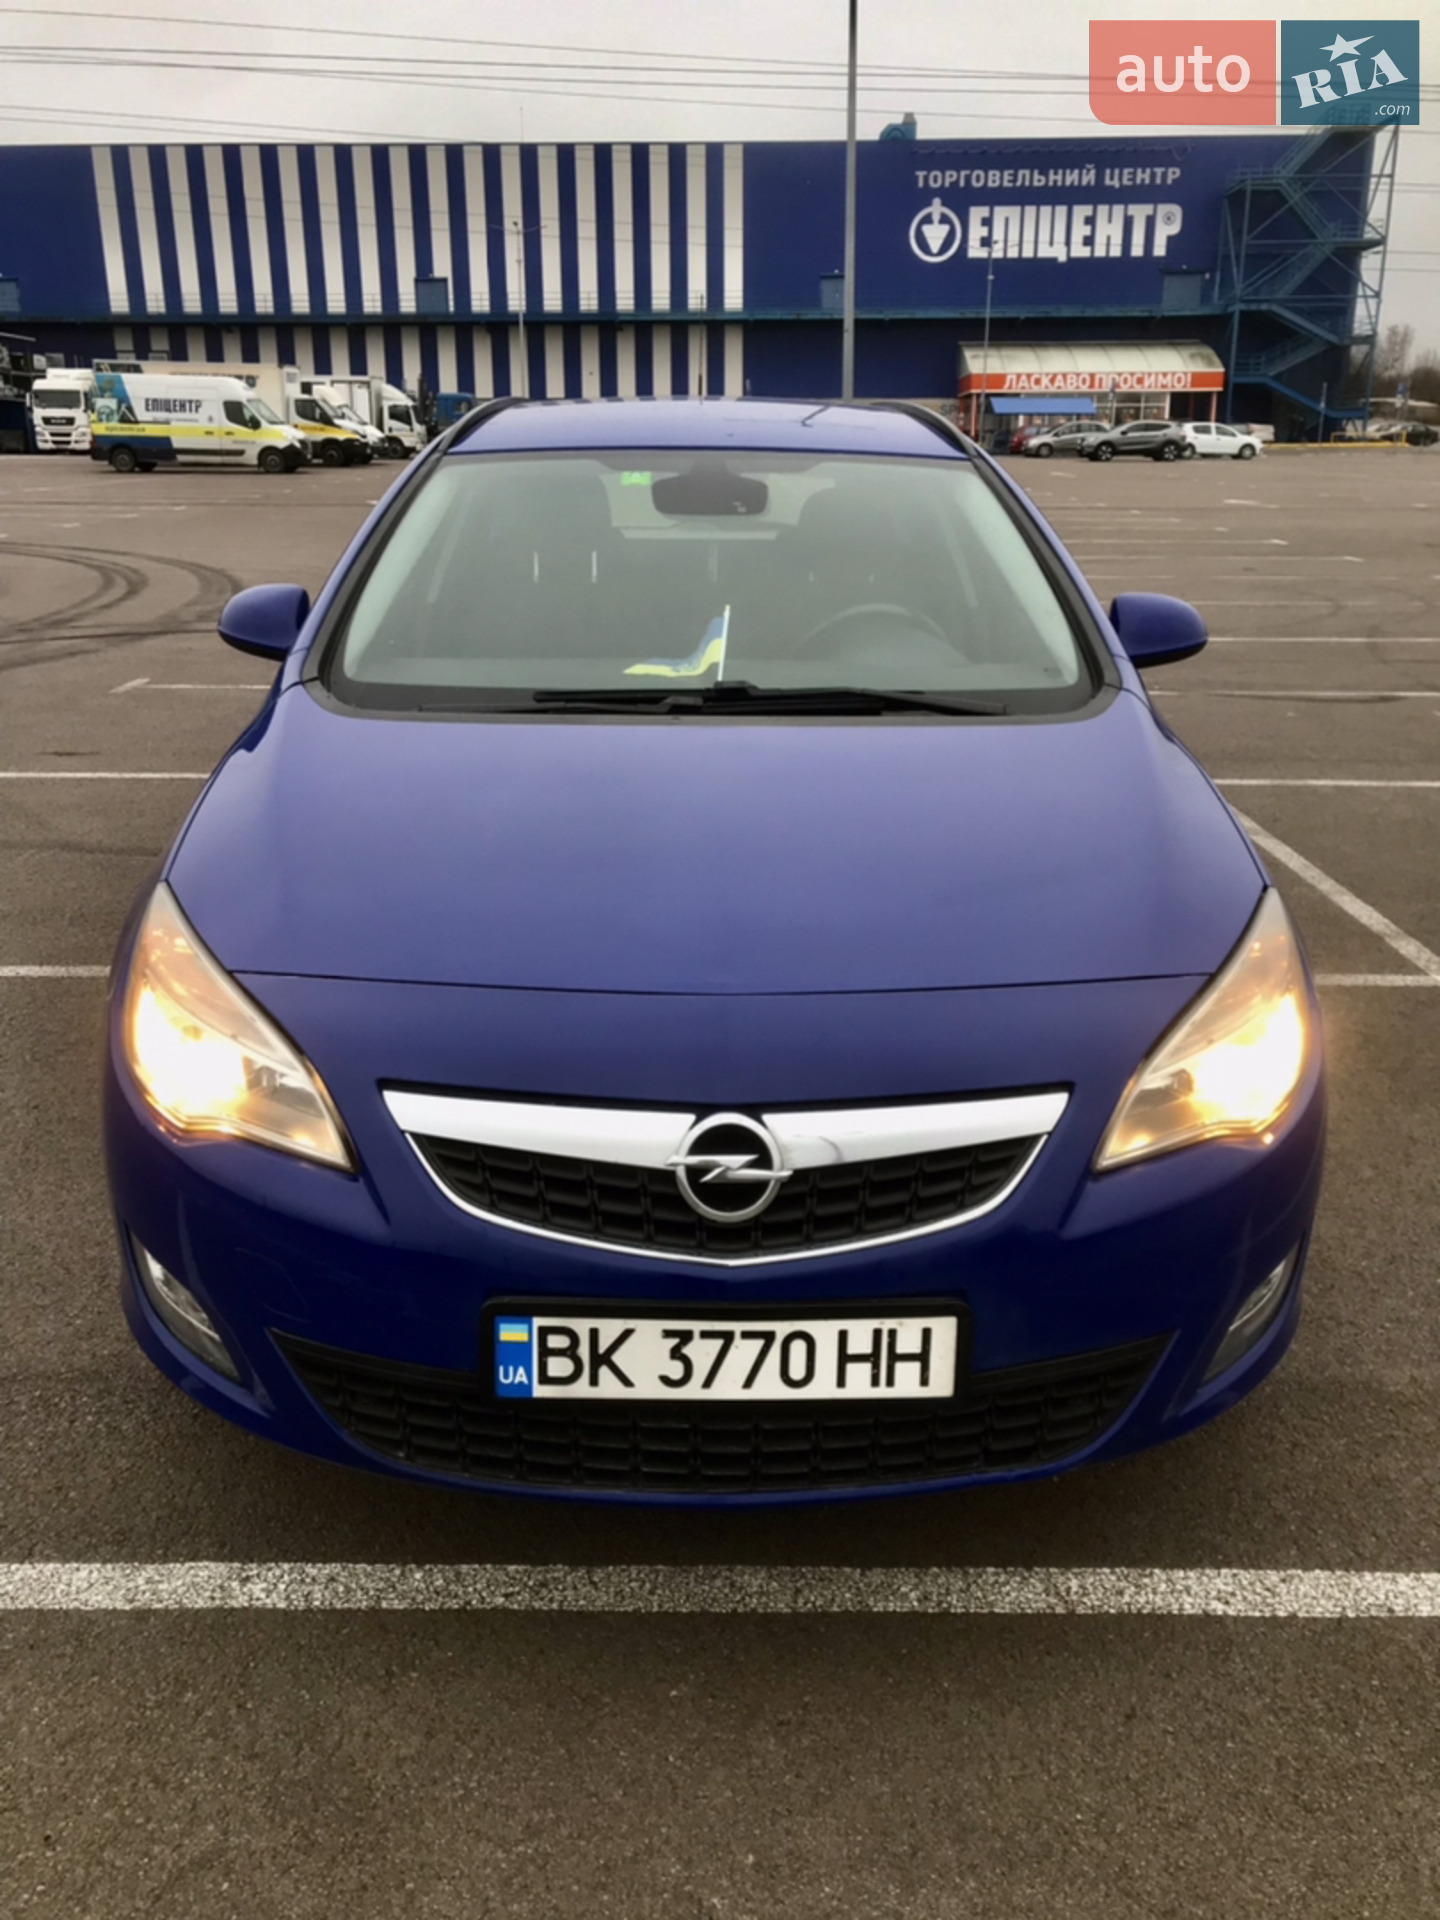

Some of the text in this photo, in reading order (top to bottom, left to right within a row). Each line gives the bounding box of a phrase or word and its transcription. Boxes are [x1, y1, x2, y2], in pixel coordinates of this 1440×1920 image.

[915, 164, 1181, 189] ТОРГОВЕЛЬНИЙ ЦЕНТР
[1003, 372, 1192, 390] ЛАСКАВО ПРОСИМО!
[145, 398, 202, 414] ЕПІЦЕНТР
[537, 1325, 932, 1389] BK 3770 HH
[499, 1366, 529, 1385] UA
